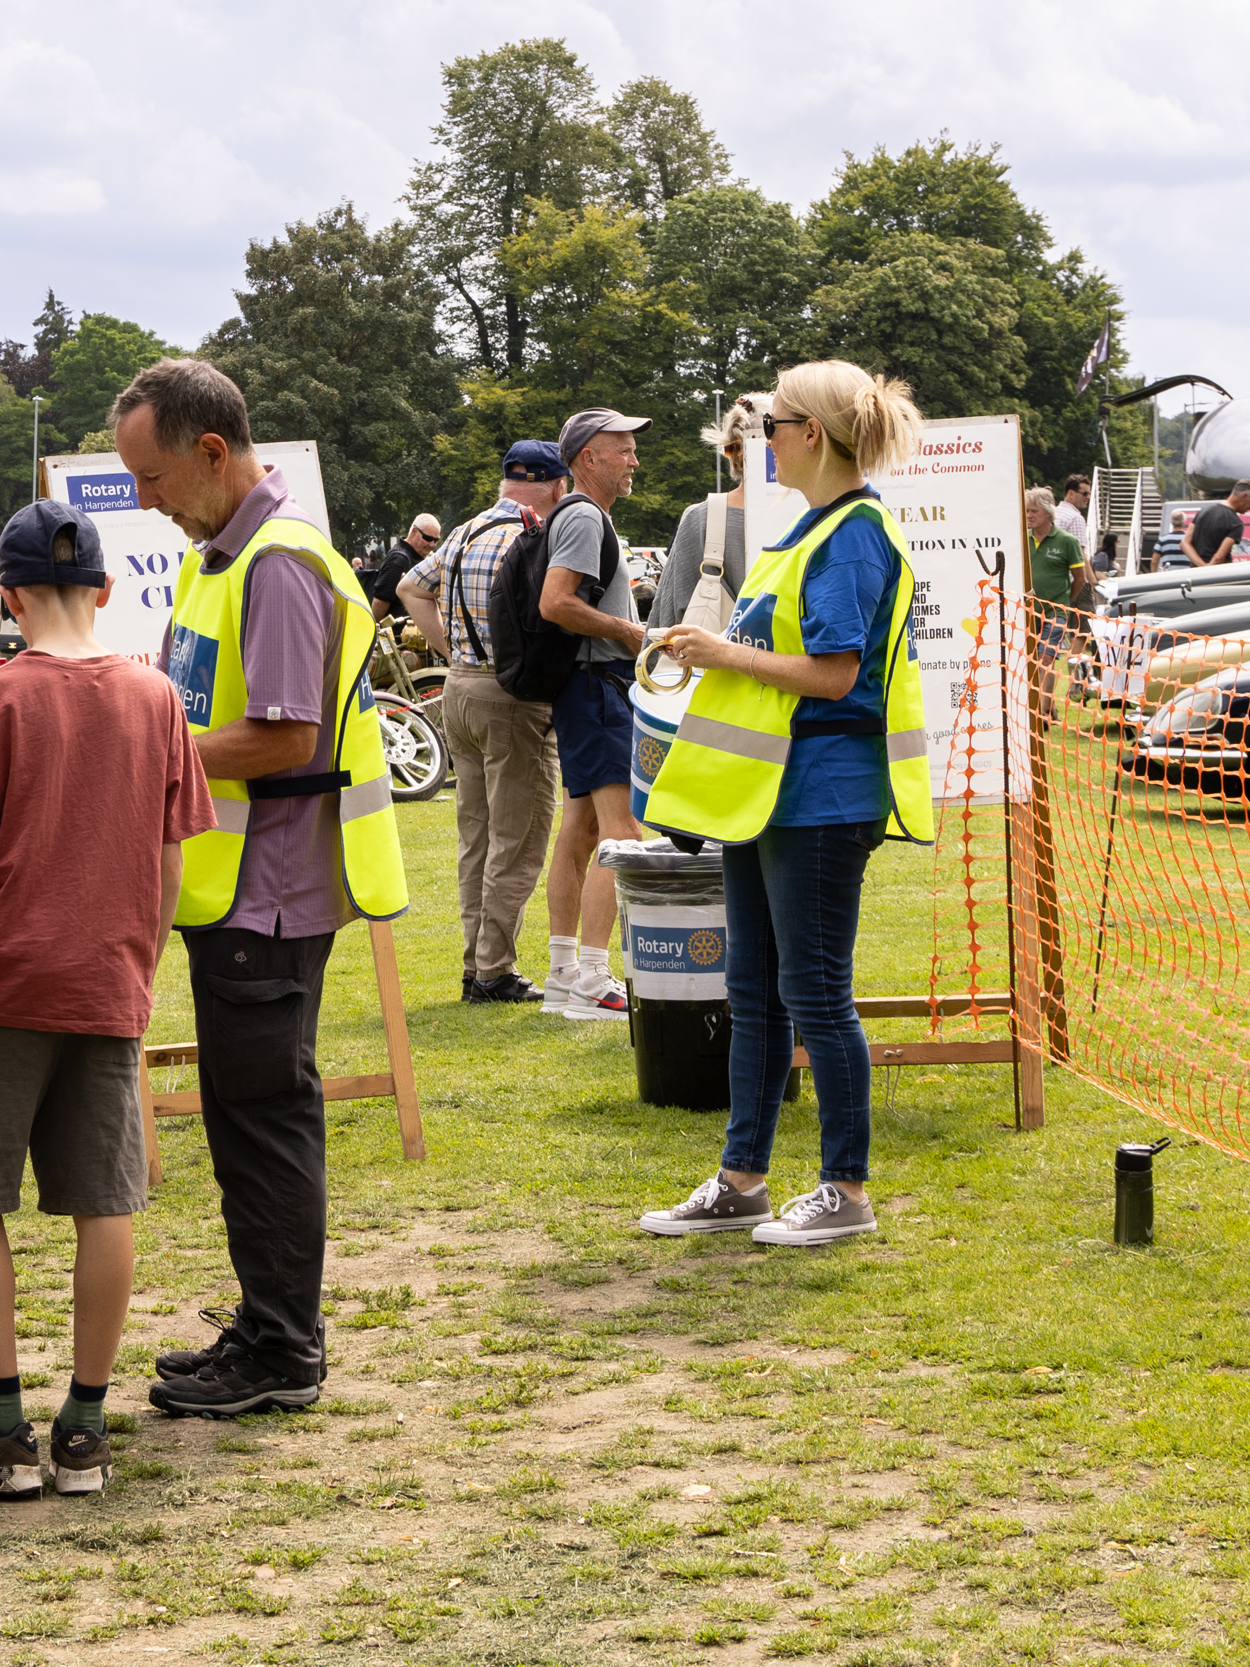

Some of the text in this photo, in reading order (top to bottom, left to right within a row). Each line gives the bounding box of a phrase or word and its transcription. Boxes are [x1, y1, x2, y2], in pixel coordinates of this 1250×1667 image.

[918, 436, 984, 457] lassics
[909, 463, 928, 475] the
[932, 462, 985, 475] Common
[81, 482, 131, 499] Rotary
[85, 499, 134, 512] Harpenden
[951, 538, 967, 550] IN
[973, 537, 1002, 549] AID
[125, 552, 168, 577] NO
[914, 581, 931, 593] OPE
[912, 593, 926, 605] ND
[914, 617, 926, 629] OR
[915, 627, 953, 641] HILDREN
[919, 660, 947, 671] onate
[949, 658, 960, 672] by
[637, 936, 684, 958] Rotary
[640, 957, 686, 970] Harpenden
[72, 1434, 87, 1442] NIKE
